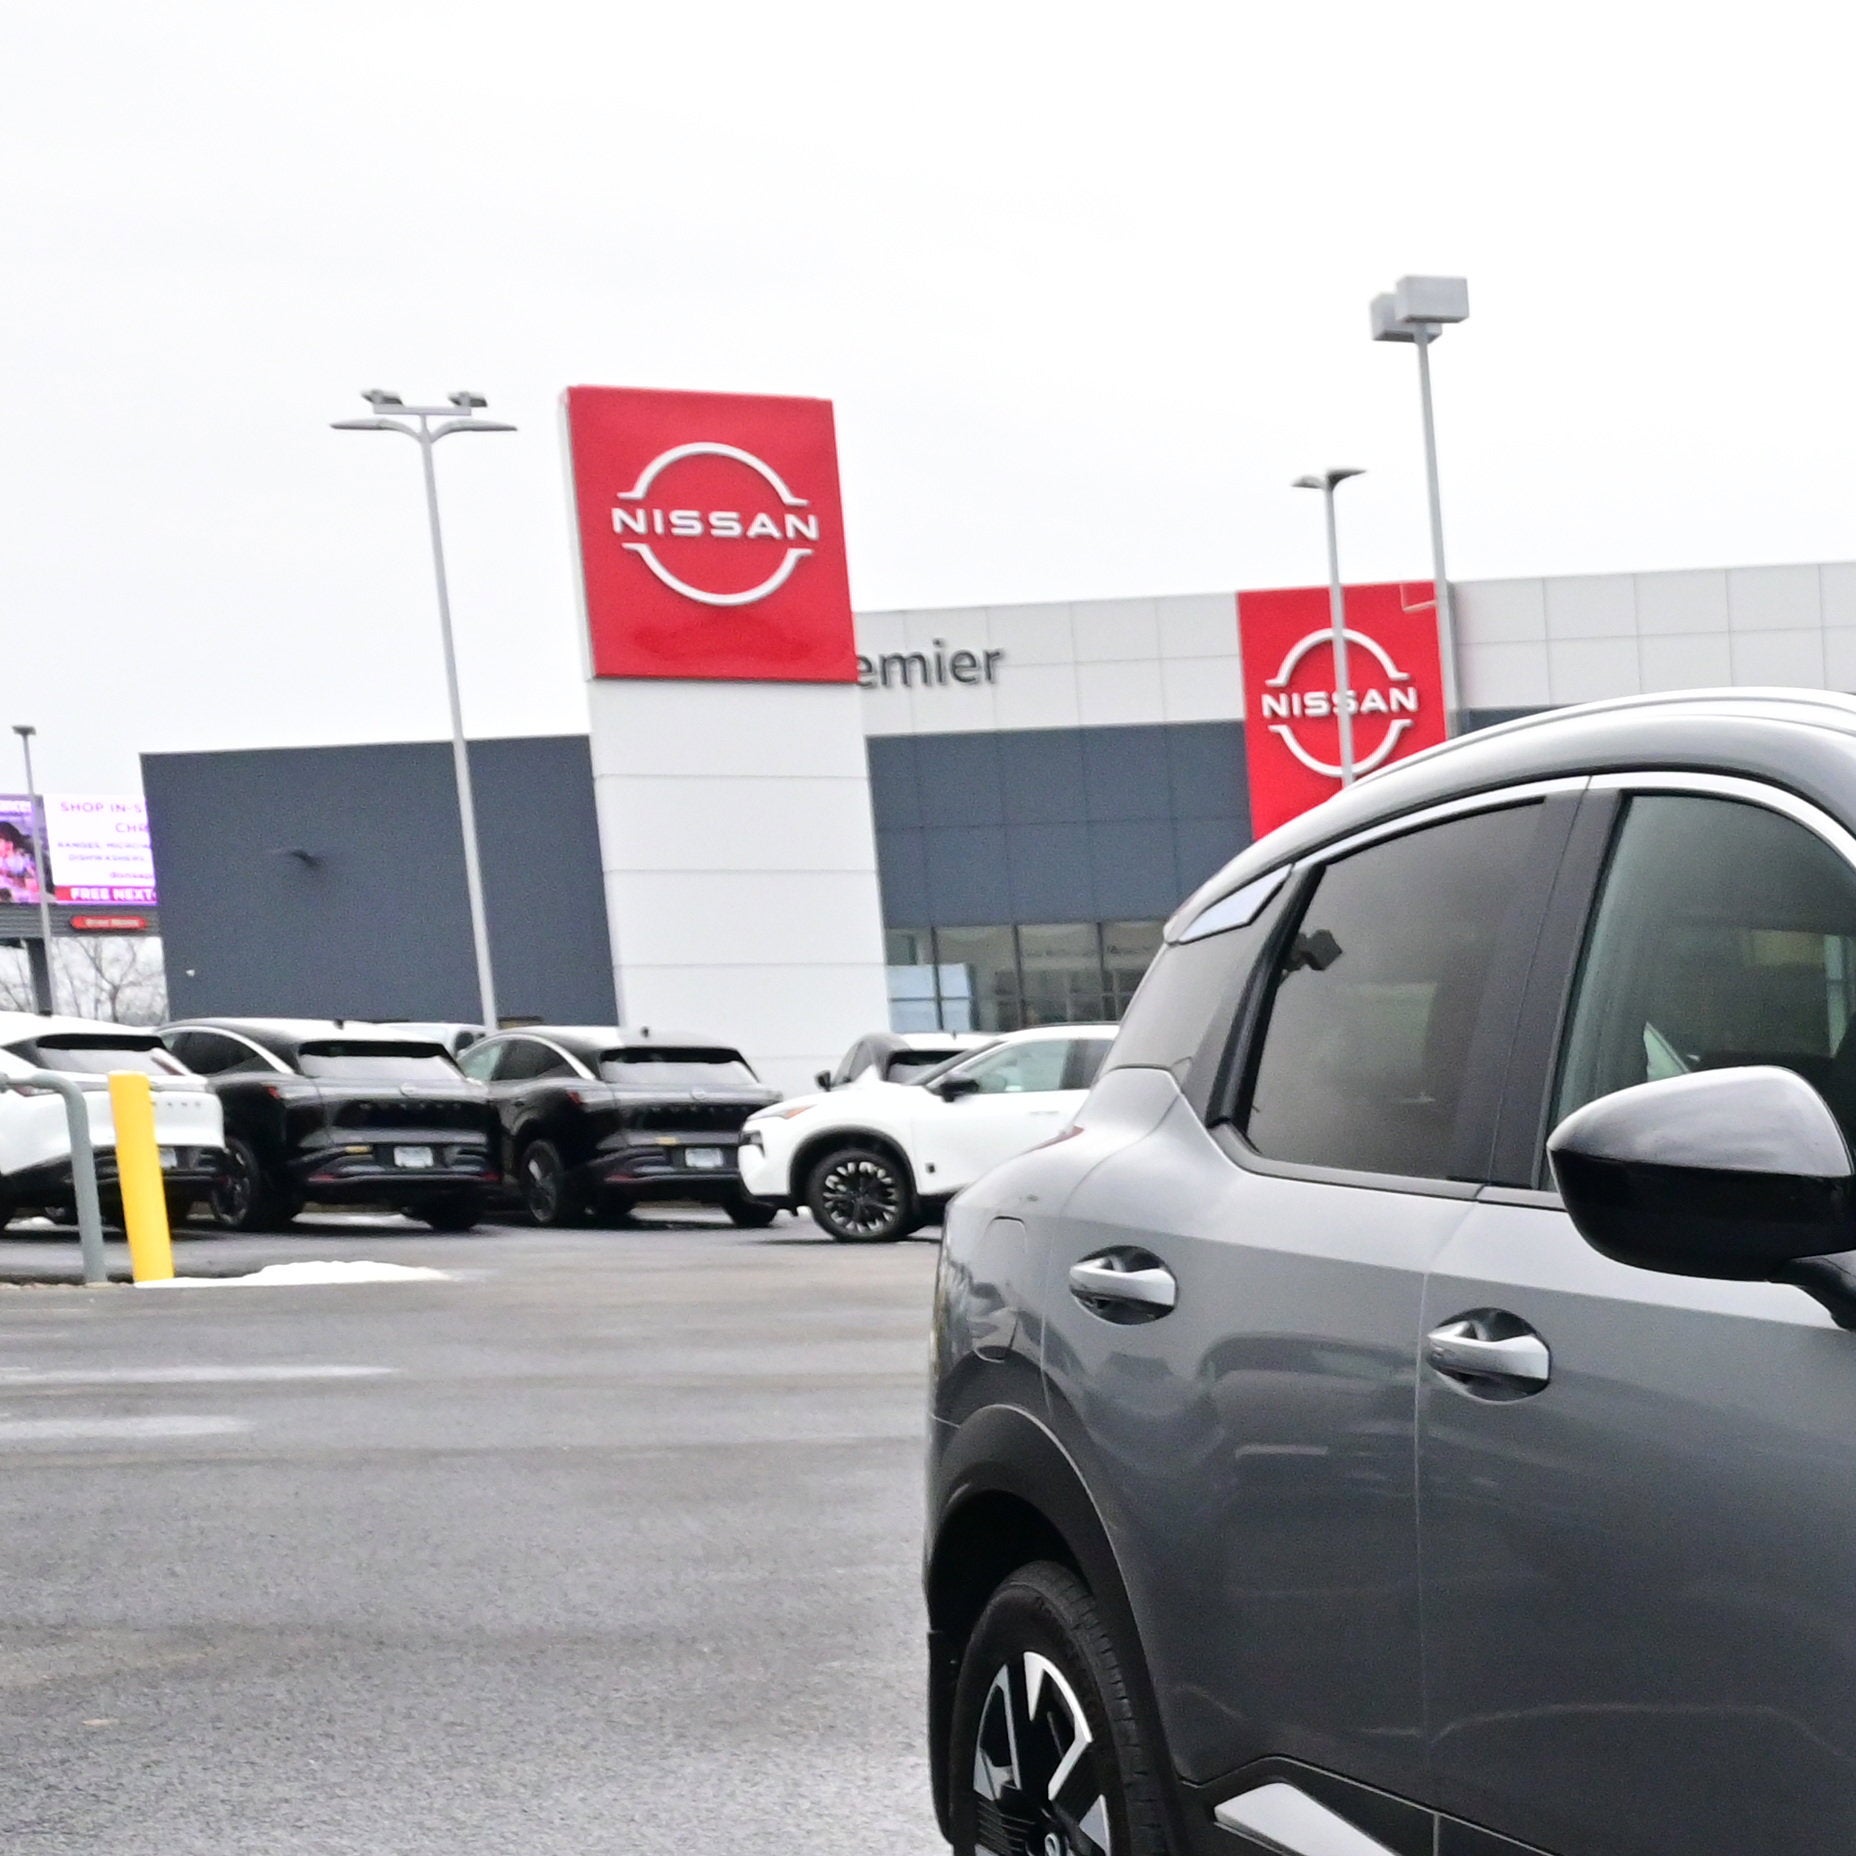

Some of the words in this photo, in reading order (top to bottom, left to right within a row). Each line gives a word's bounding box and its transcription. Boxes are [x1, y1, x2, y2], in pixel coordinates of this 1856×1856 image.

[611, 507, 819, 541] NISSAN
[60, 802, 104, 813] SHOP
[70, 887, 110, 900] FREE
